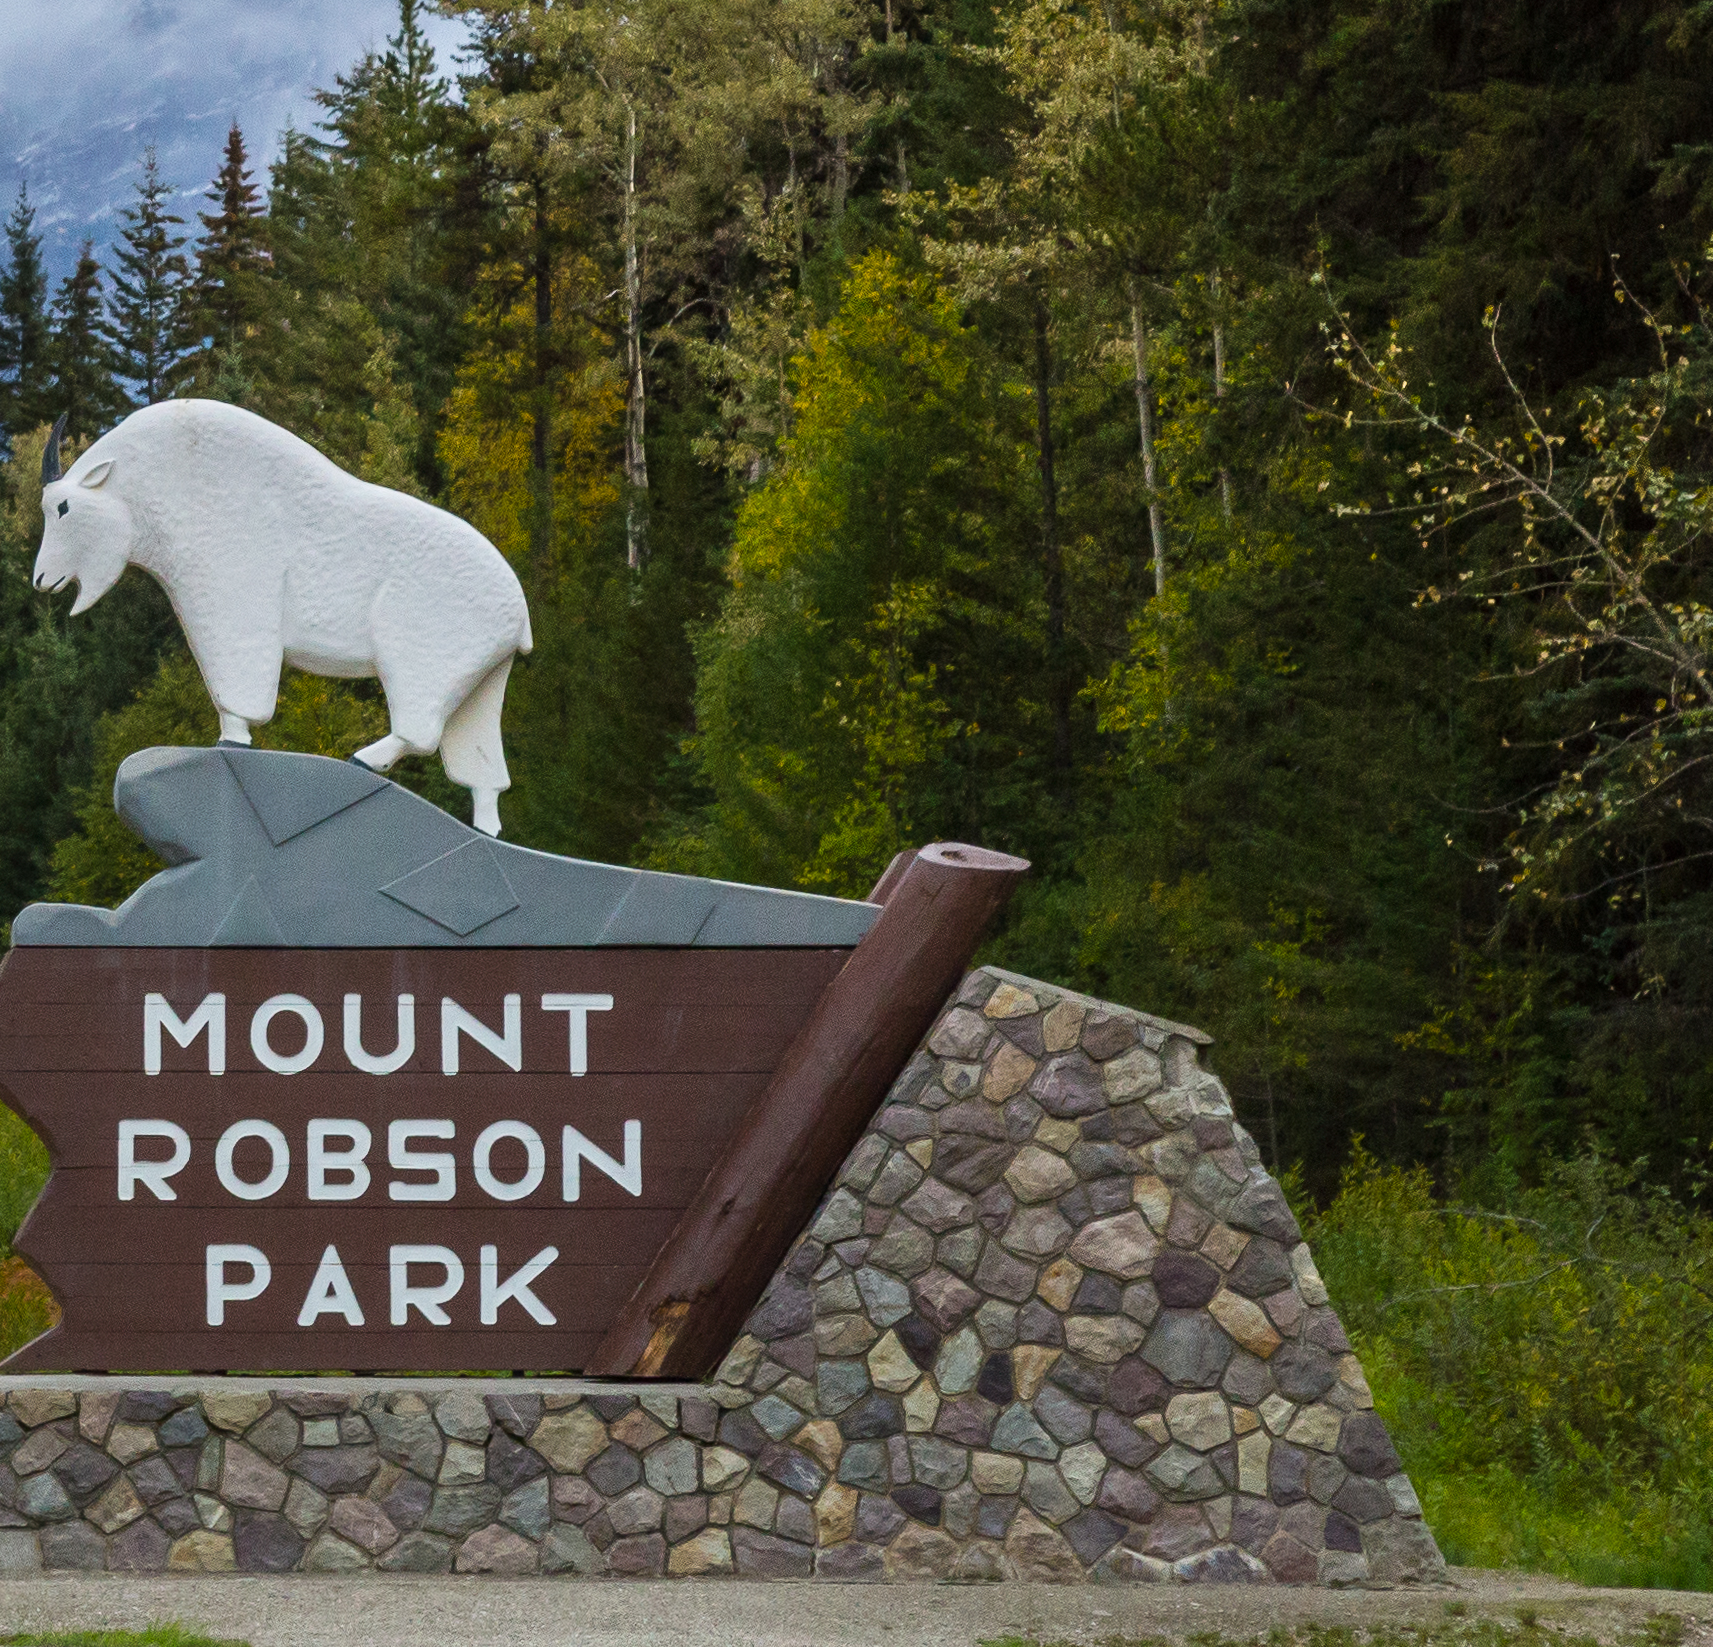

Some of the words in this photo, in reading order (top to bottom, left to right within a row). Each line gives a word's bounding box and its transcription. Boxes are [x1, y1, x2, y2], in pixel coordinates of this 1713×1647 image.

[143, 992, 614, 1076] MOUNT
[117, 1118, 643, 1202] ROBSON
[205, 1244, 560, 1327] PARK
